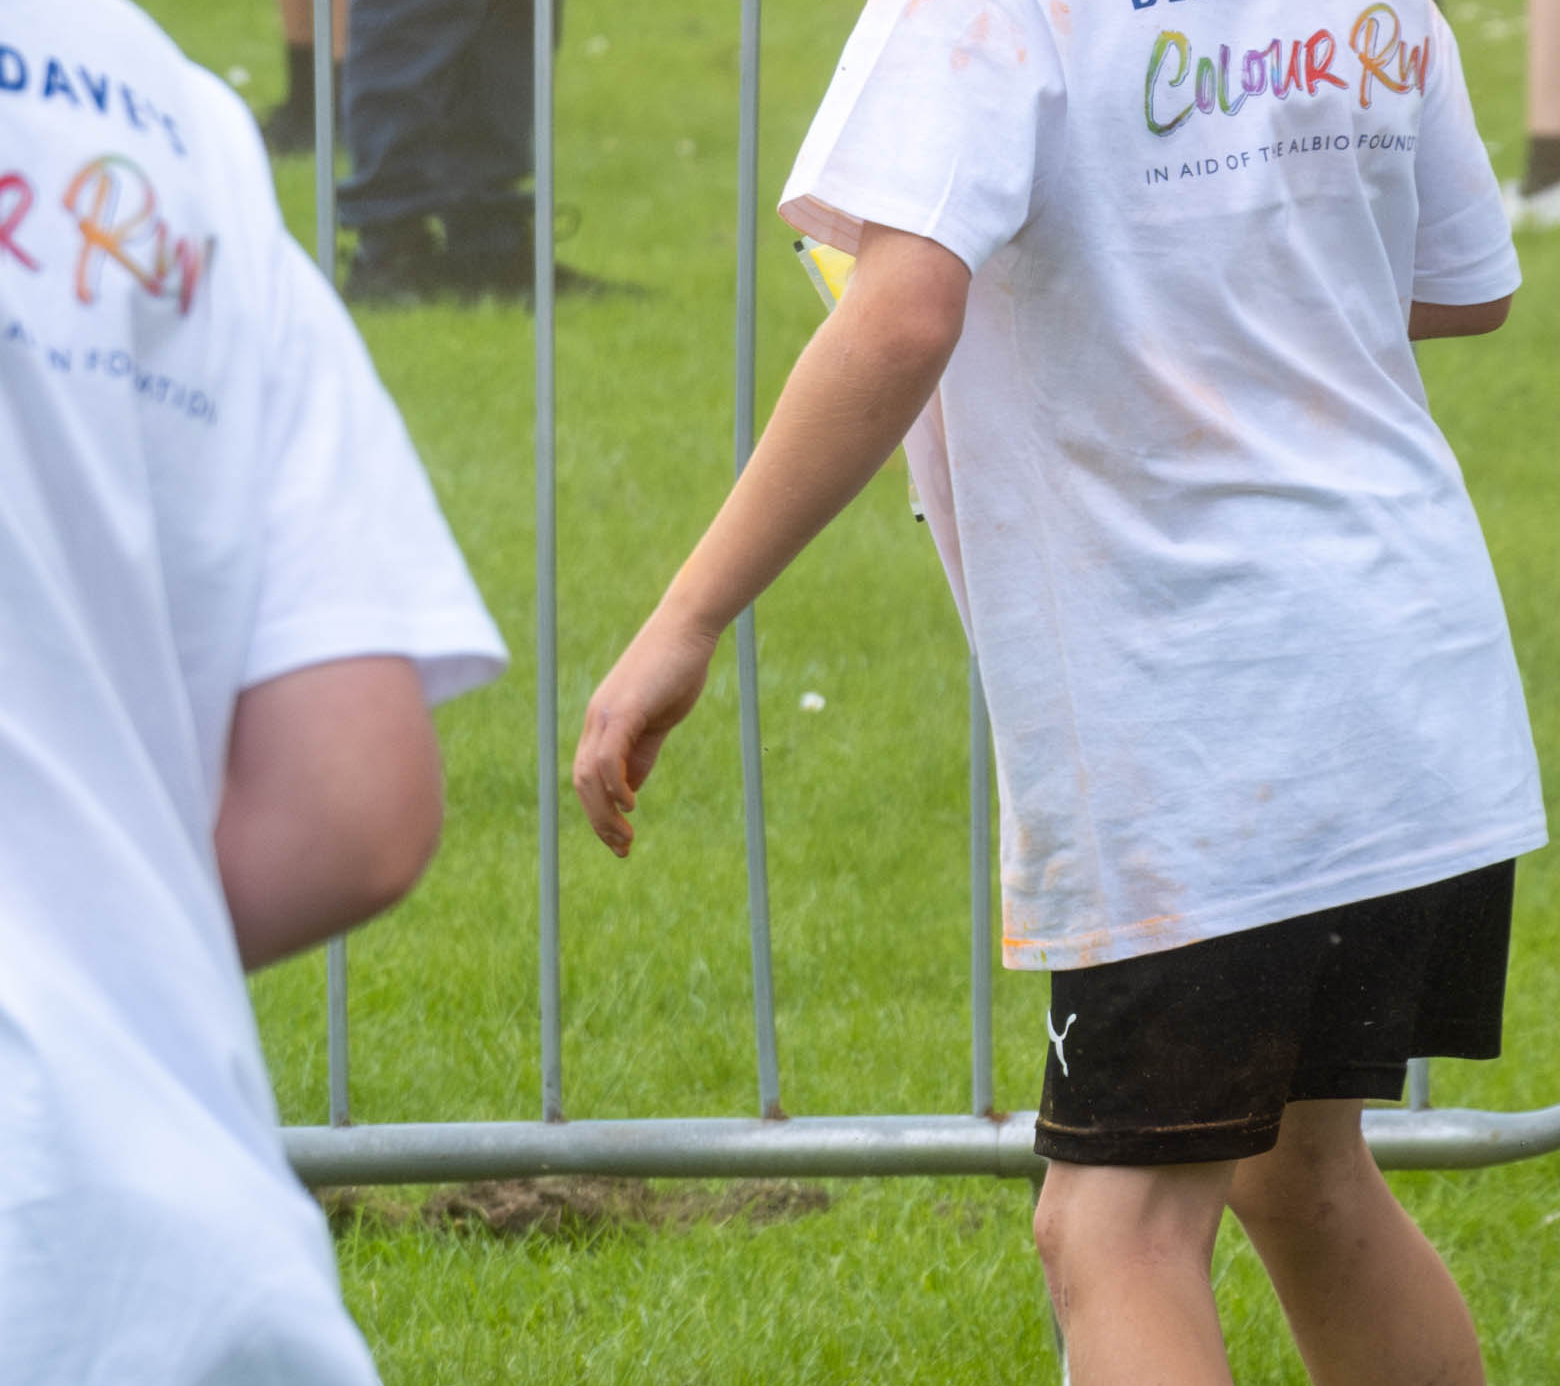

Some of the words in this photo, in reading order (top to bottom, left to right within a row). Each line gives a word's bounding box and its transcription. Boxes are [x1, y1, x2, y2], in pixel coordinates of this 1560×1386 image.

[1145, 166, 1169, 186] IN
[1179, 158, 1220, 179] AID
[1225, 151, 1252, 172] OF
